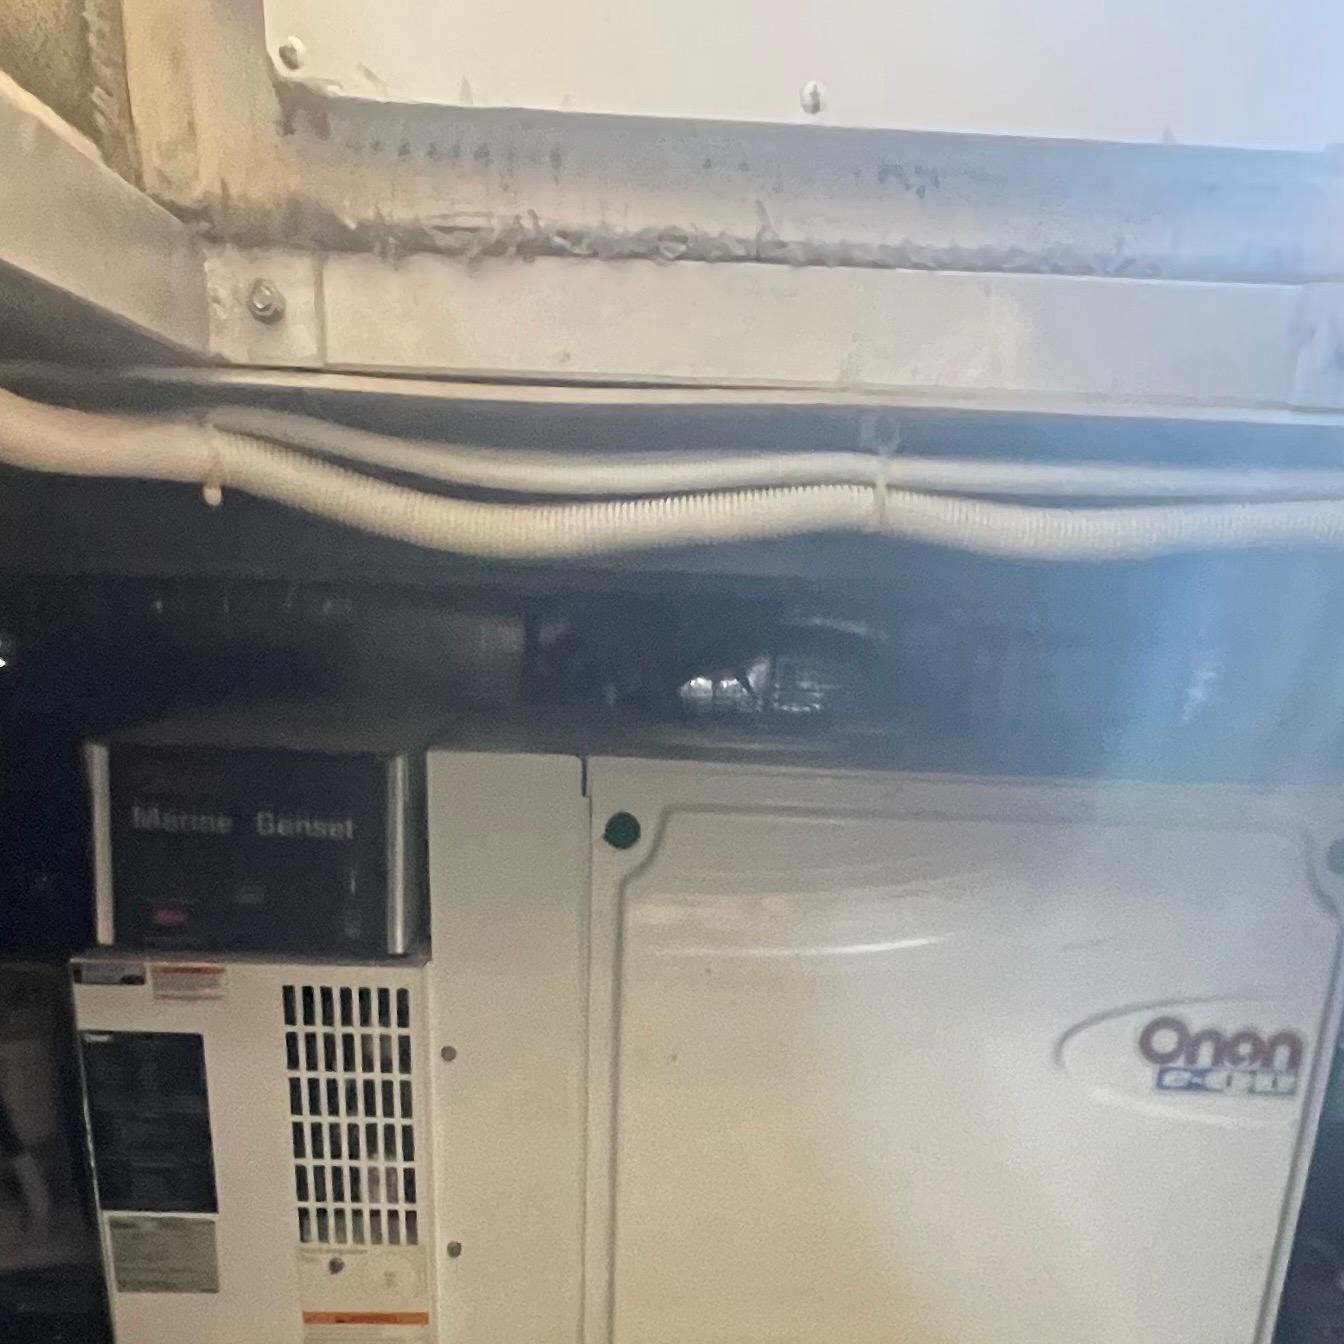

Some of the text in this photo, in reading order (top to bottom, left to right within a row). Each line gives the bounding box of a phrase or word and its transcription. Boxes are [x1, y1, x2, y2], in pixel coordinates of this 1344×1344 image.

[131, 805, 353, 839] Marine Genset
[1139, 1016, 1303, 1070] Onan
